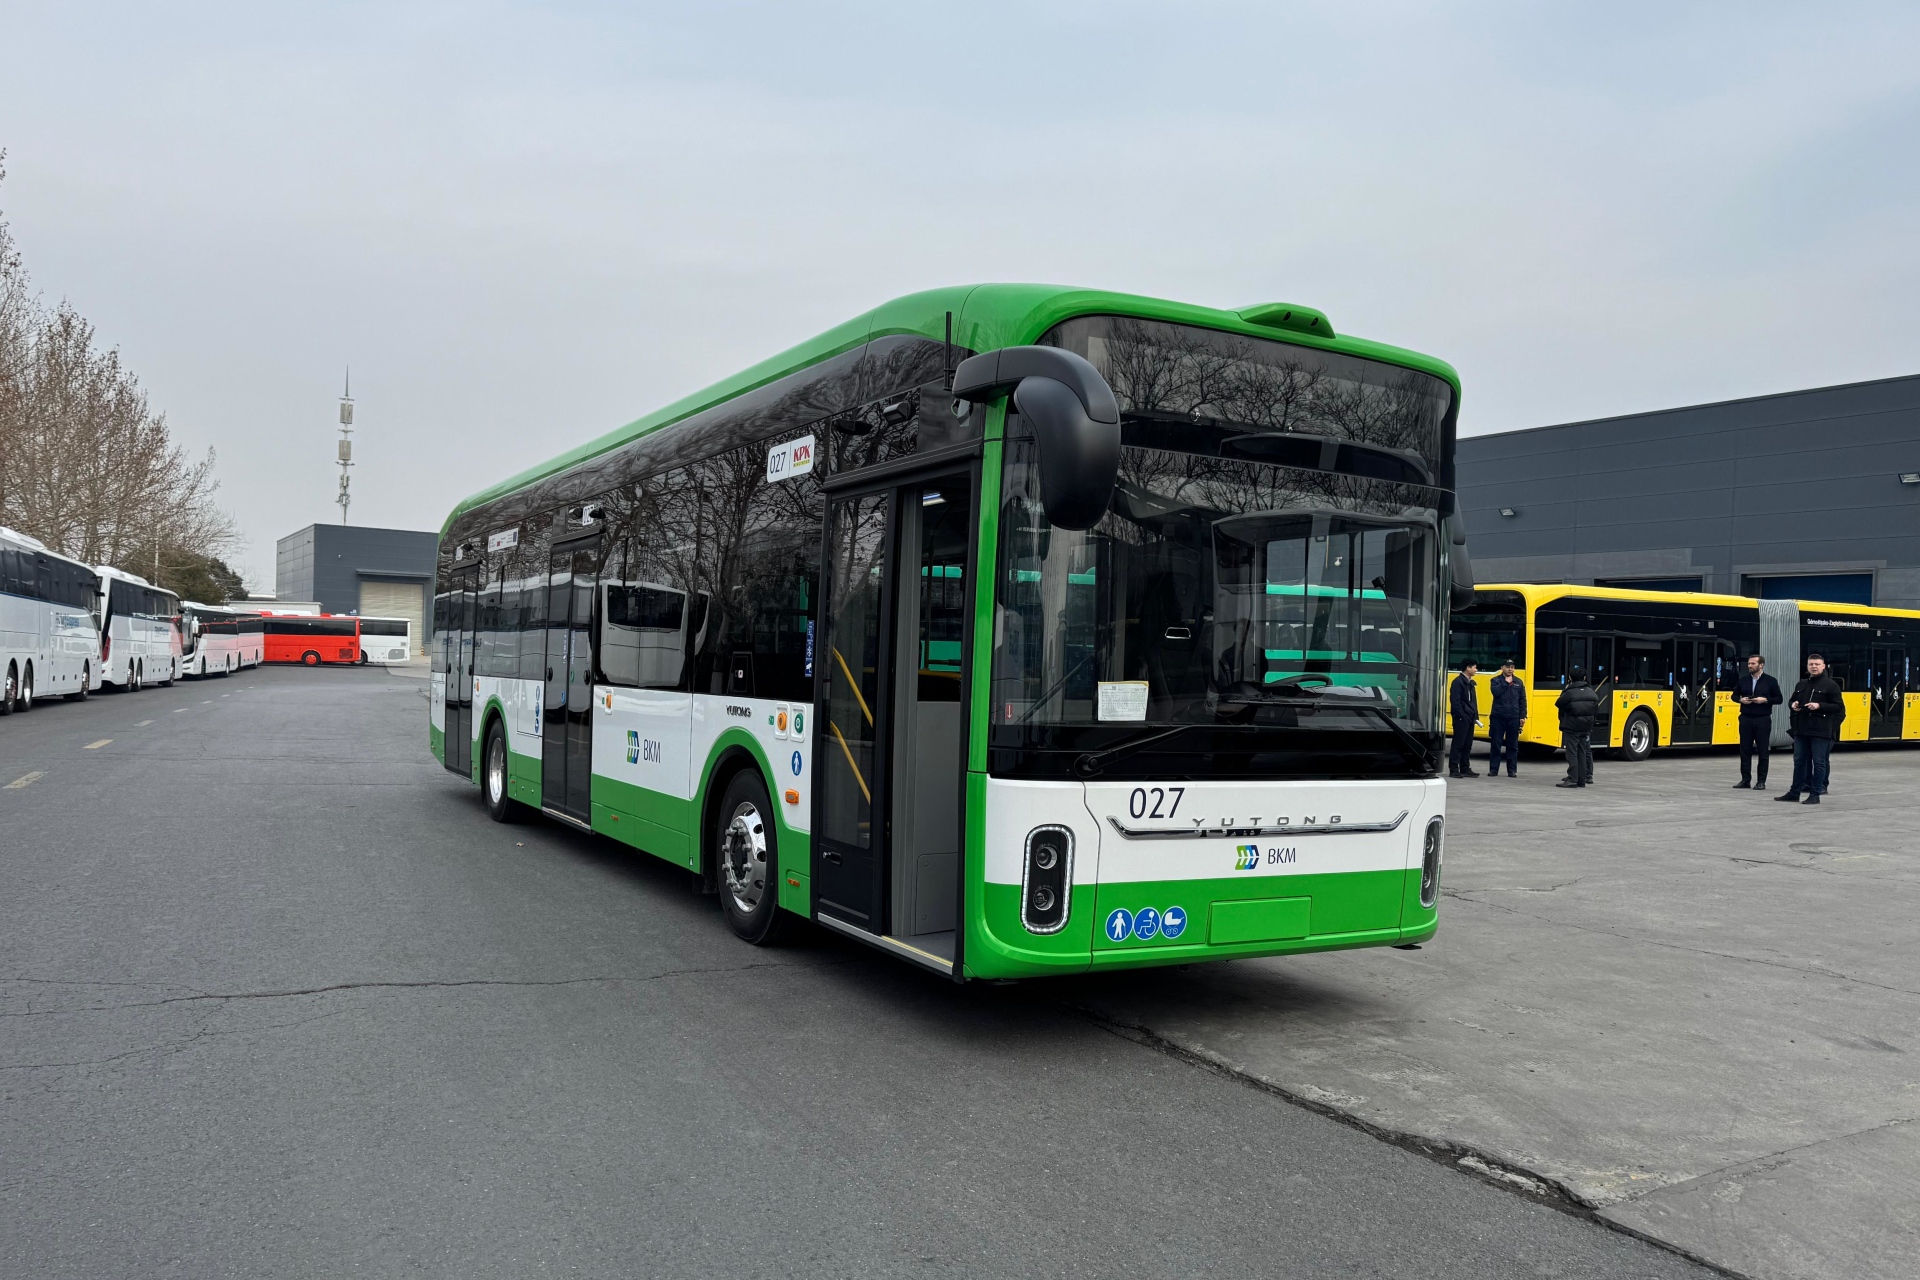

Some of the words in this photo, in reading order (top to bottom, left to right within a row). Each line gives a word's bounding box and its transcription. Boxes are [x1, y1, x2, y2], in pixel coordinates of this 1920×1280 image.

[769, 450, 787, 474] 027
[793, 443, 811, 463] KPK
[726, 704, 752, 718] YUTONG
[643, 738, 661, 764] BKM
[1129, 787, 1186, 819] 027
[1192, 815, 1342, 828] YUTONG
[1267, 847, 1296, 865] BKM
